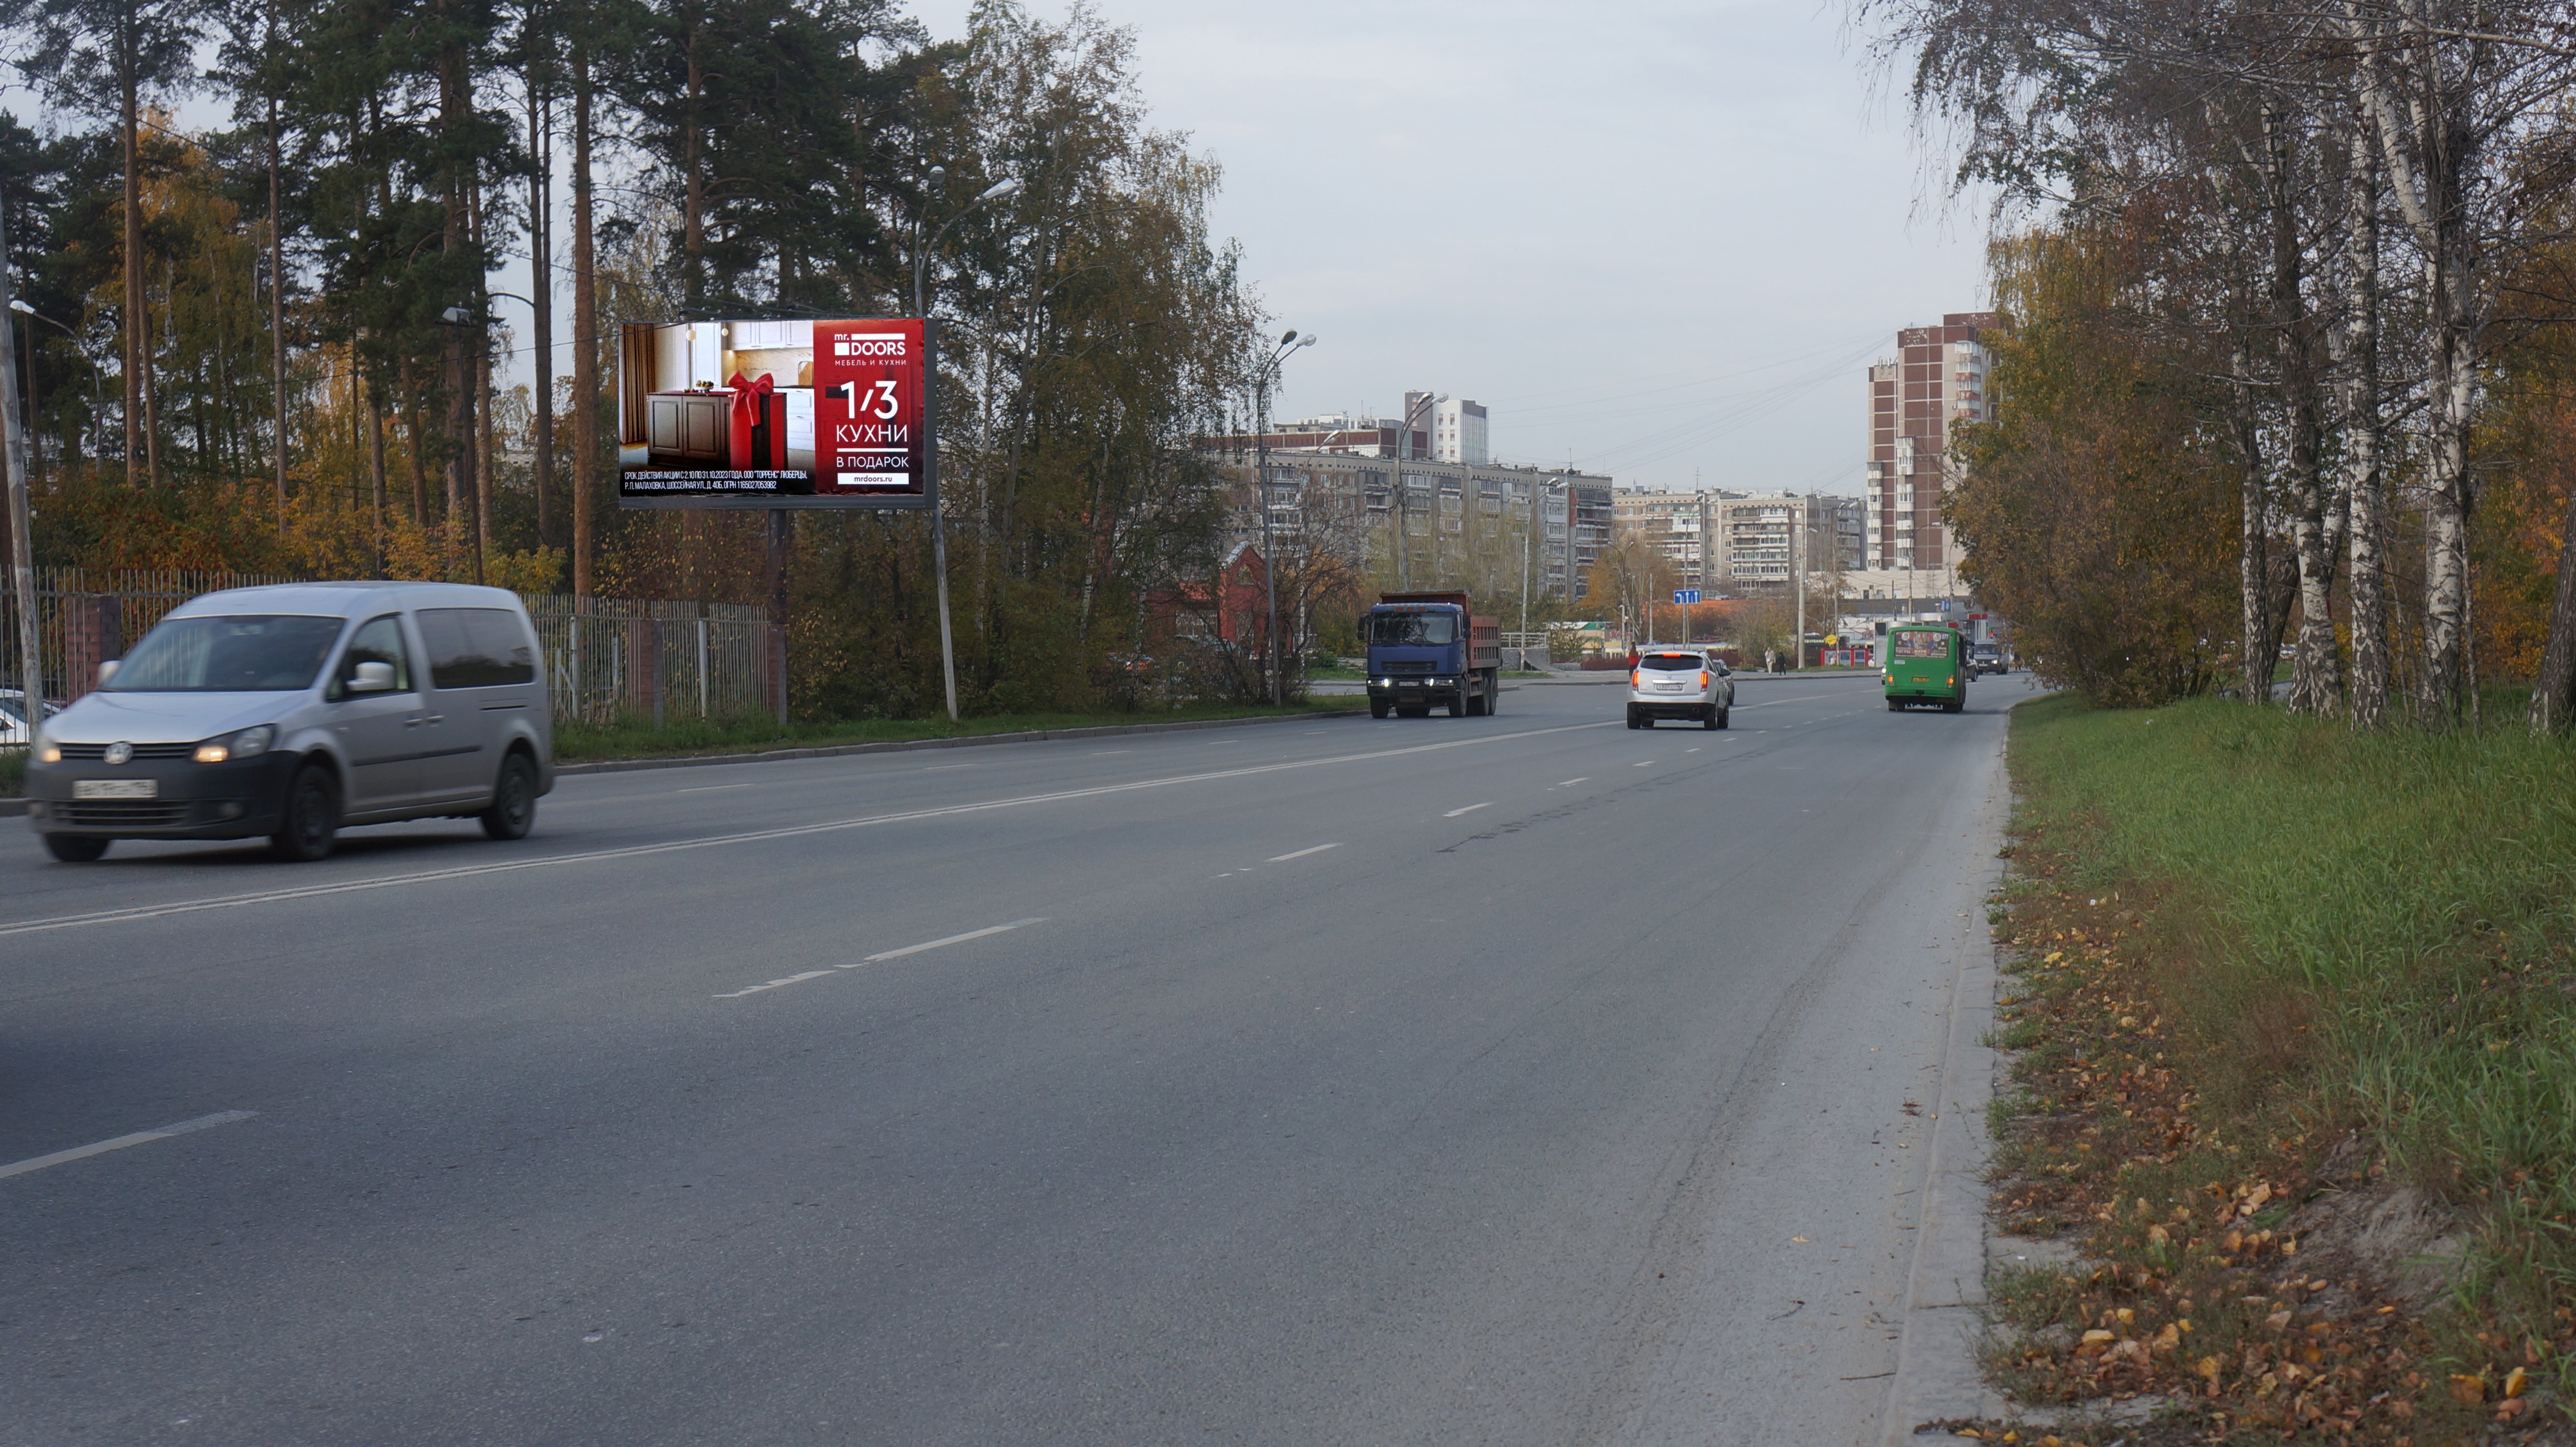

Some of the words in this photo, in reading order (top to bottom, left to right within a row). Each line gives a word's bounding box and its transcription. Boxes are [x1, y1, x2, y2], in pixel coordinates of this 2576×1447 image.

[851, 342, 905, 355] DOORS
[841, 381, 898, 419] 1/3
[836, 425, 907, 442] КУХНИ
[837, 457, 844, 467] В
[849, 457, 909, 469] ПОДАРОК
[638, 470, 662, 480] ДЕЙСТВИЯ
[729, 471, 743, 479] ГОДА.
[780, 471, 807, 479] ЛЮБЕРЦЫ,
[667, 480, 696, 489] ШОССЕЙНАЯ
